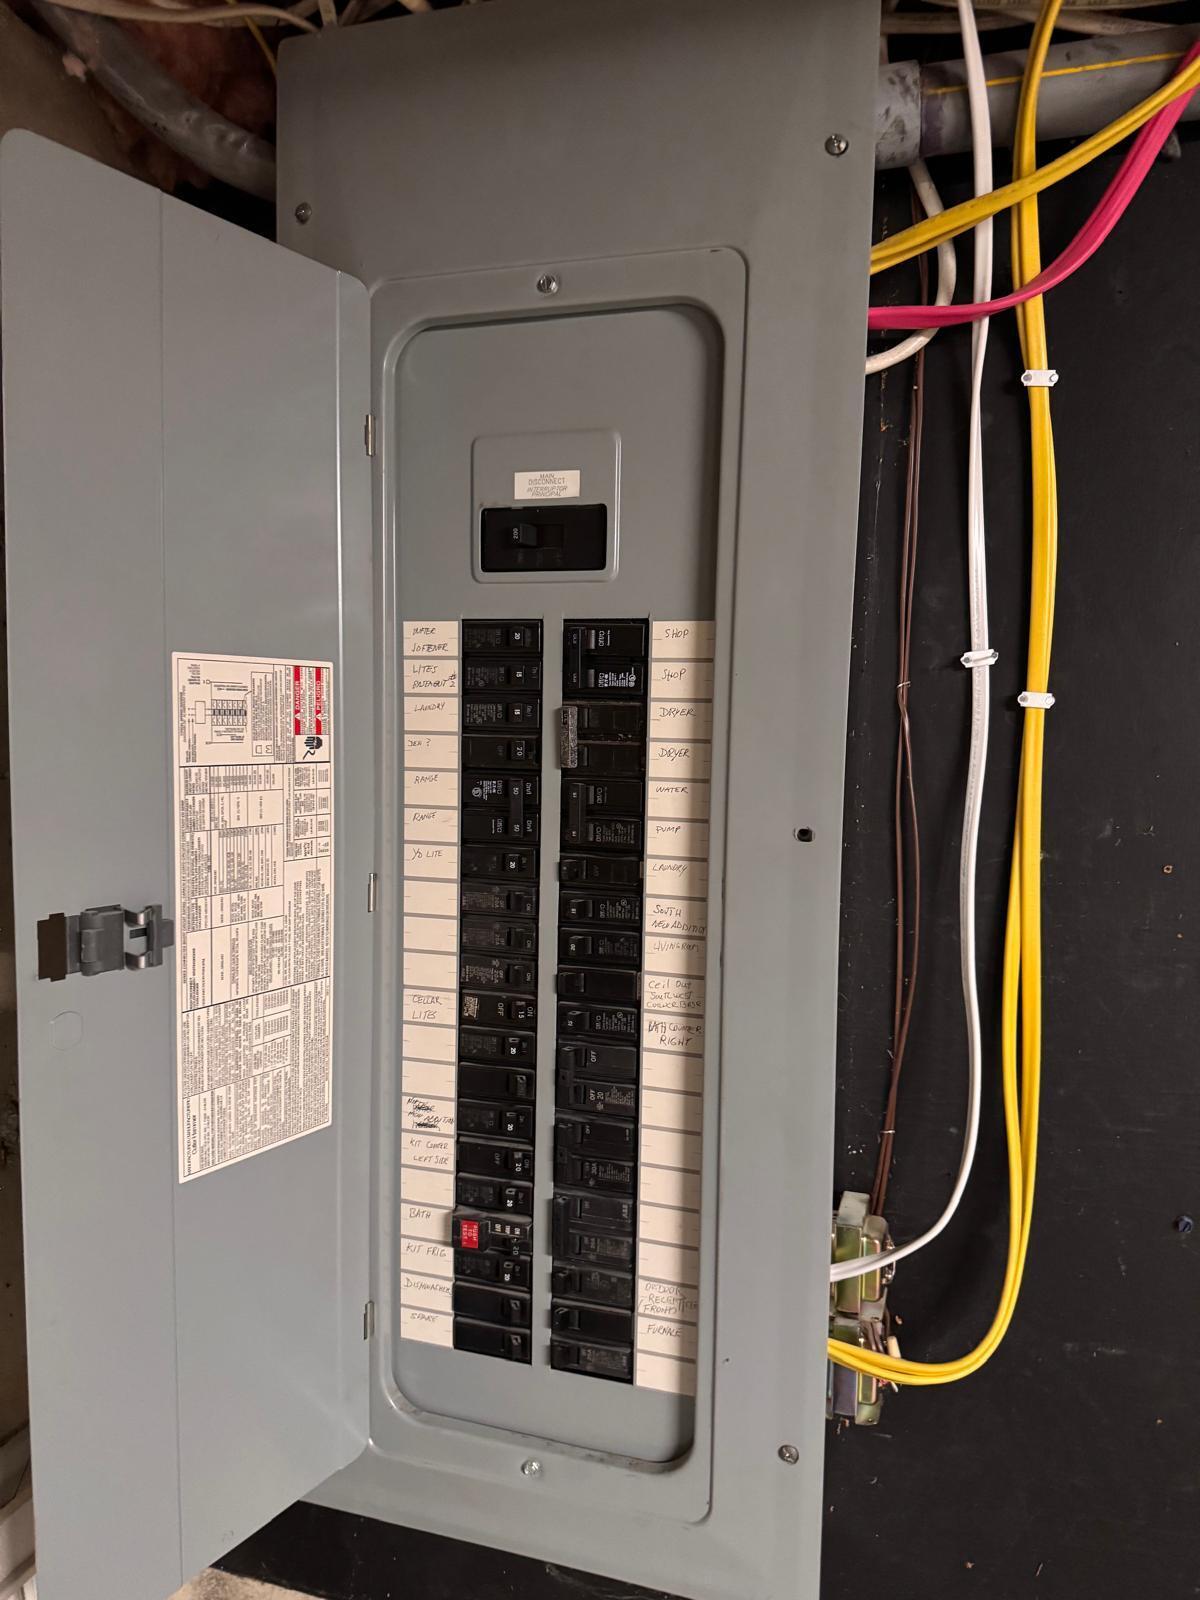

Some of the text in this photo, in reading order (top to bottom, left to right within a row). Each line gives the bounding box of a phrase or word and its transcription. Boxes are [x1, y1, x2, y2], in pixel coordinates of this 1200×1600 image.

[528, 478, 565, 486] DISCONNECT
[514, 632, 521, 640] 20
[665, 628, 689, 639] SHOP
[661, 668, 687, 682] SHOP
[659, 707, 696, 718] DRYER
[516, 746, 523, 756] 20
[658, 748, 690, 762] DRYER
[414, 774, 440, 784] RANGE
[655, 786, 688, 794] WATER
[655, 826, 681, 834] PUMP
[510, 861, 516, 869] 20
[653, 905, 682, 917] SOUTH
[519, 1011, 525, 1019] 15
[527, 1006, 534, 1017] ON
[660, 1036, 692, 1046] RIGHT
[516, 1163, 522, 1172] 20
[409, 1208, 431, 1219] BATH
[467, 1228, 472, 1237] TO
[514, 1227, 520, 1235] ON
[406, 1242, 447, 1257] KIT FRIG
[513, 1246, 519, 1256] 20
[504, 1273, 510, 1281] 20
